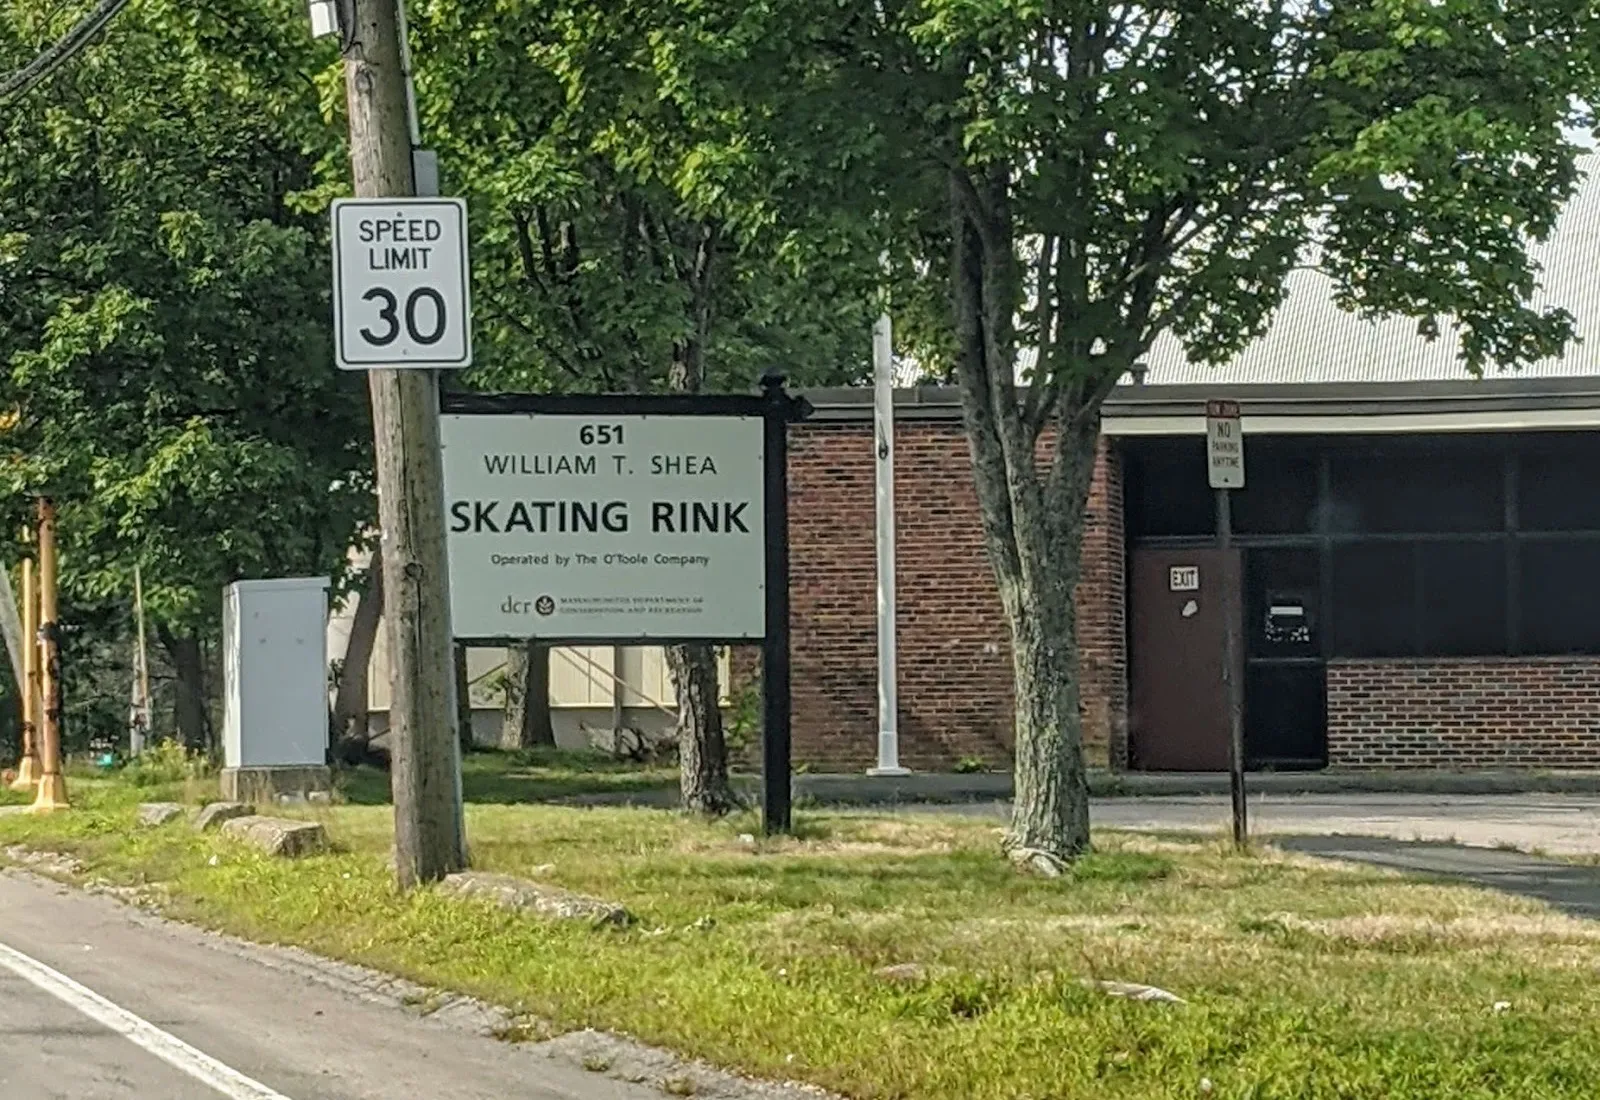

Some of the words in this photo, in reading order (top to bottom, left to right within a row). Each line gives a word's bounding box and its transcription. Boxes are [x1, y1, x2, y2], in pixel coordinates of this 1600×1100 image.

[359, 220, 441, 242] SPEED
[369, 248, 432, 270] LIMIT
[359, 286, 447, 347] 30
[579, 424, 625, 445] 651
[1217, 422, 1231, 438] NO
[484, 455, 596, 475] WILLIAM
[612, 455, 634, 475] T.
[651, 455, 717, 475] SHEA
[451, 501, 629, 533] SKATING
[652, 501, 750, 533] RINK
[491, 554, 549, 566] Operated
[555, 554, 570, 567] by
[575, 554, 598, 565] The
[604, 554, 649, 565] O'Toole
[654, 554, 710, 567] Company
[1173, 570, 1196, 586] EXIT
[501, 595, 532, 615] dcr
